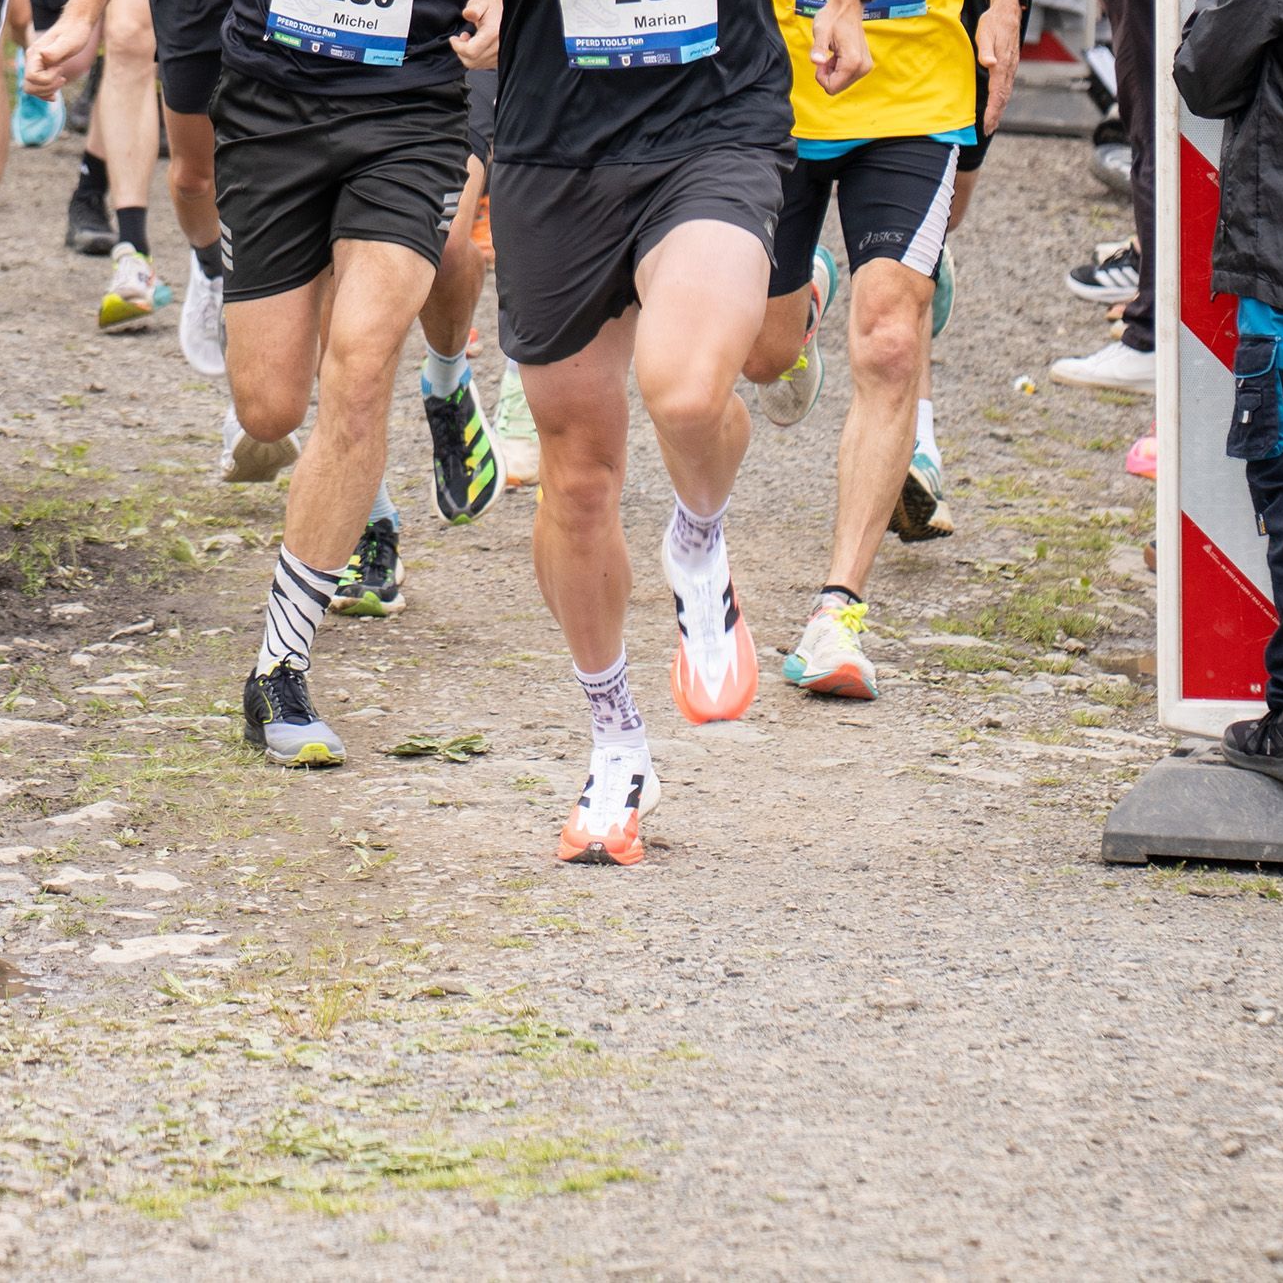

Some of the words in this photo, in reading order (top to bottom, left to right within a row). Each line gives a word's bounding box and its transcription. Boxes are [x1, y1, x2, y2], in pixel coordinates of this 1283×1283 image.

[277, 16, 299, 29] PFERD
[299, 23, 322, 36] TOOLS
[322, 28, 337, 38] Run
[333, 13, 378, 30] Michel
[634, 13, 687, 29] Marian
[575, 38, 601, 48] PFERD
[601, 38, 627, 47] TOOLS
[628, 37, 644, 46] Run
